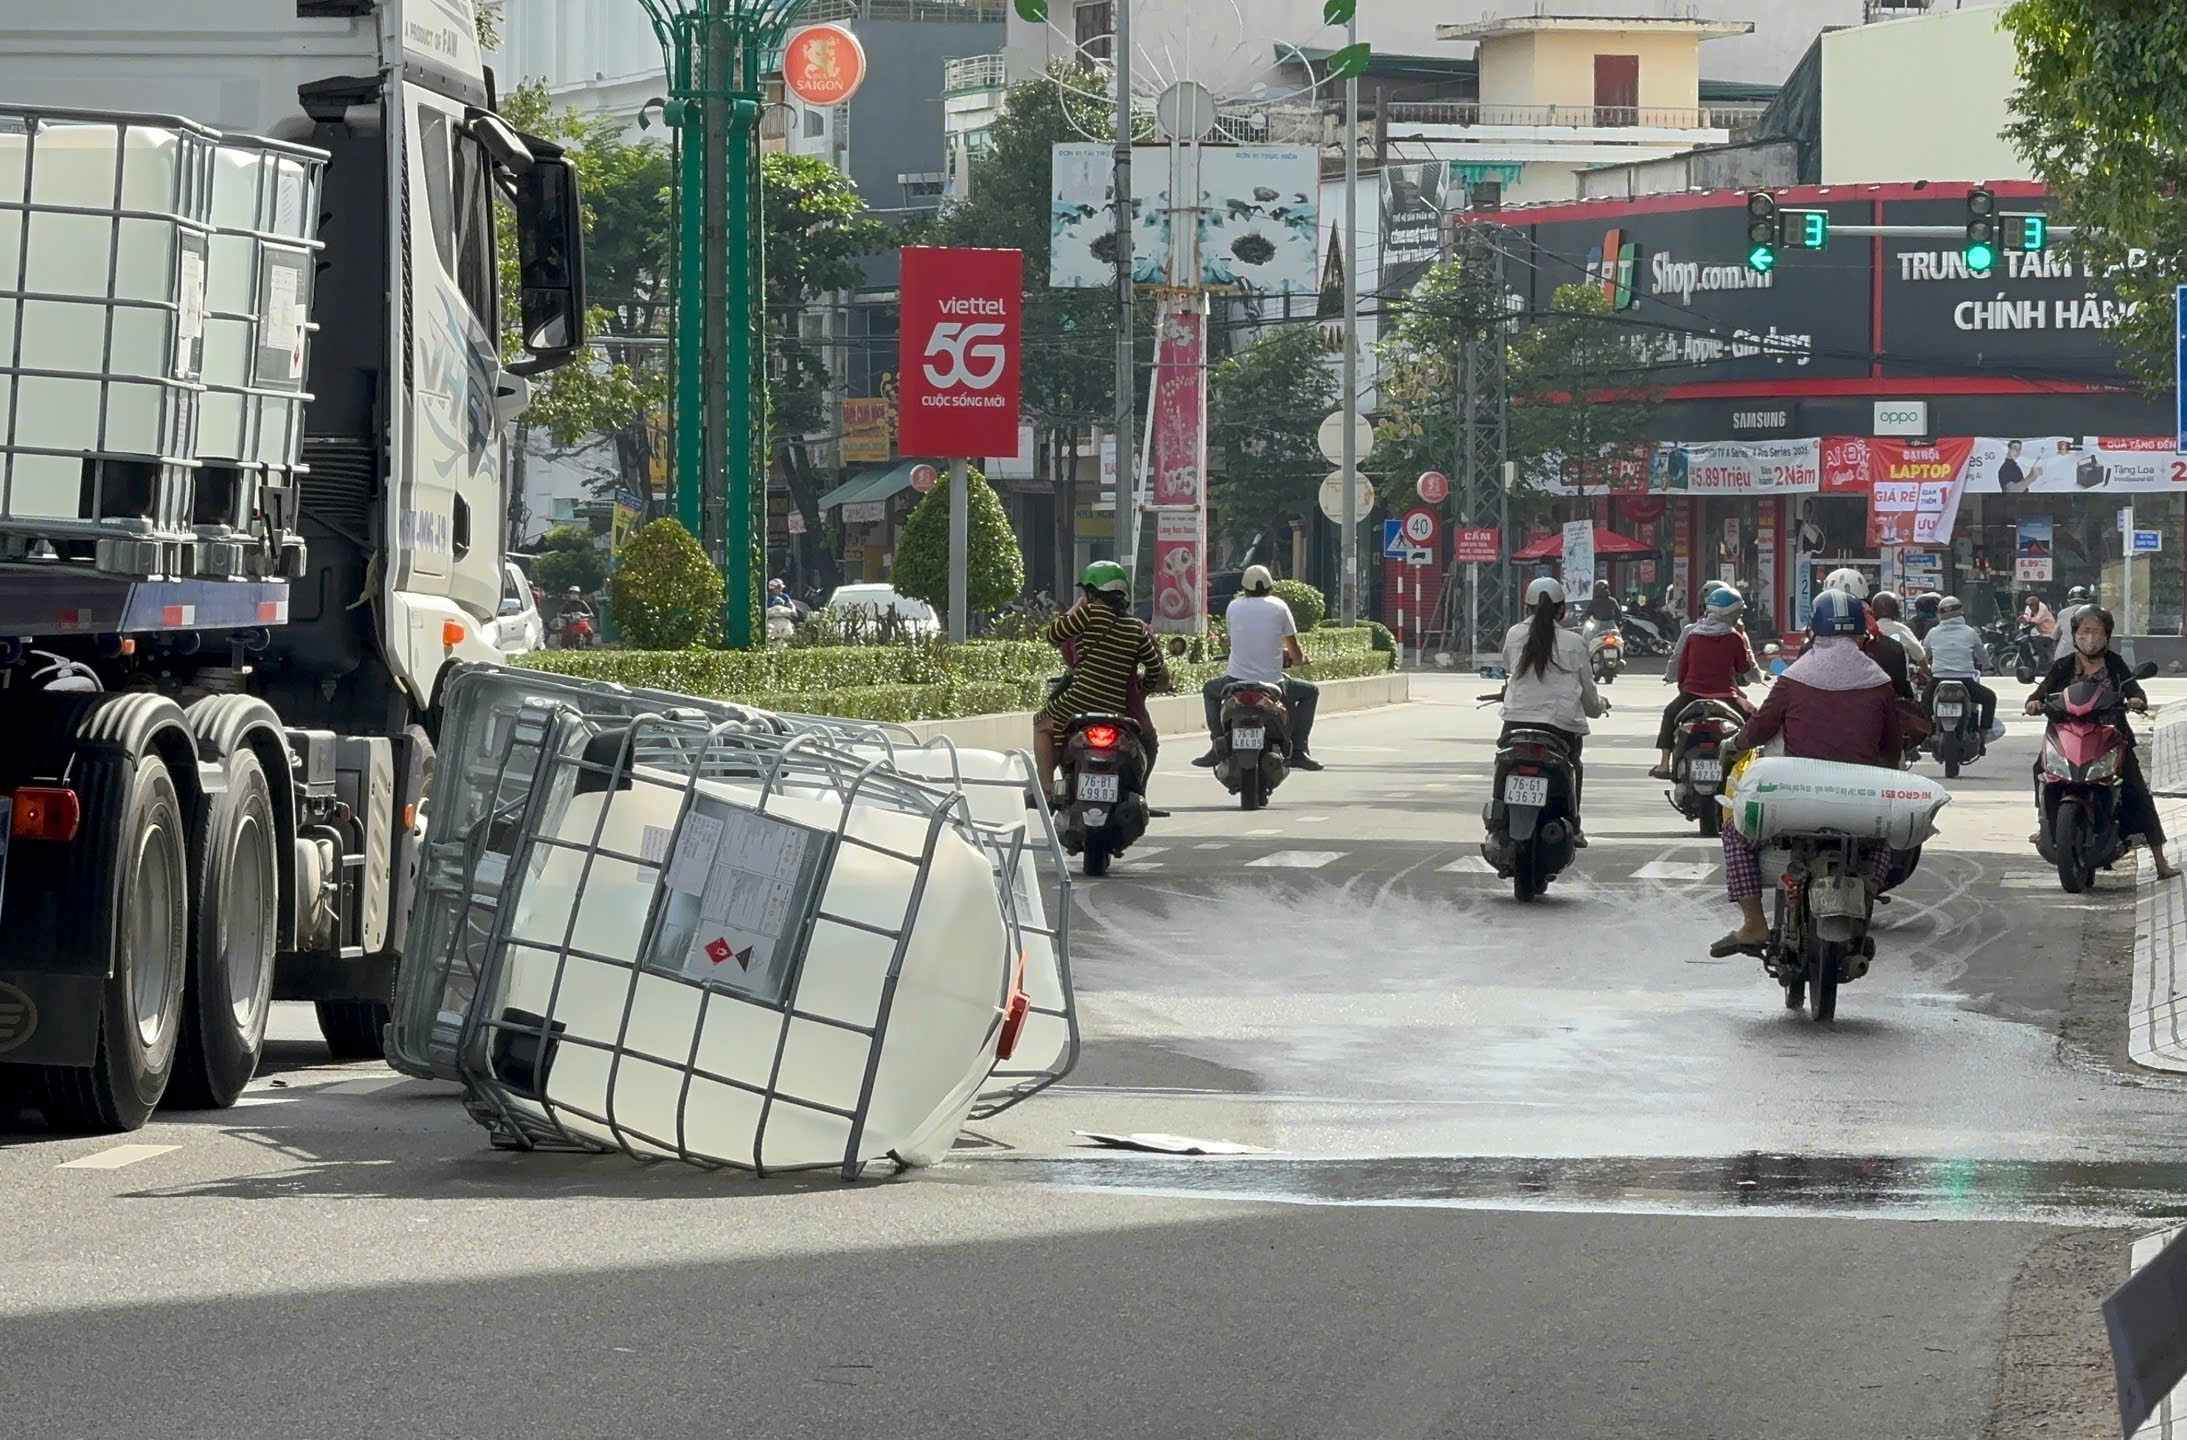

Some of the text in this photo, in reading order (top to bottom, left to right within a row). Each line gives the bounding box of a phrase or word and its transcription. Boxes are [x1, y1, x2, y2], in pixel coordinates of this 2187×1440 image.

[442, 28, 458, 58] FAW
[796, 79, 844, 91] SAIGON
[1804, 214, 1823, 247] 3
[2024, 217, 2042, 249] 3
[938, 296, 1007, 315] viettel
[1953, 291, 2047, 331] CHÍNH
[922, 321, 1006, 390] 5G
[921, 391, 1006, 408] CUỘC SỐNG MỚI
[1732, 410, 1787, 429] SAMSUNG
[1879, 411, 1918, 424] oppo
[1695, 466, 1719, 487] 5.89
[1720, 465, 1752, 492] Triệu
[1774, 465, 1784, 486] 2
[1785, 463, 1816, 486] Năm
[1889, 464, 1952, 479] LAPTOP
[2113, 464, 2155, 476] Tặng Loa
[1875, 485, 1917, 503] GIÁ RẺ
[1411, 518, 1429, 536] 40
[1464, 530, 1491, 541] CẤM
